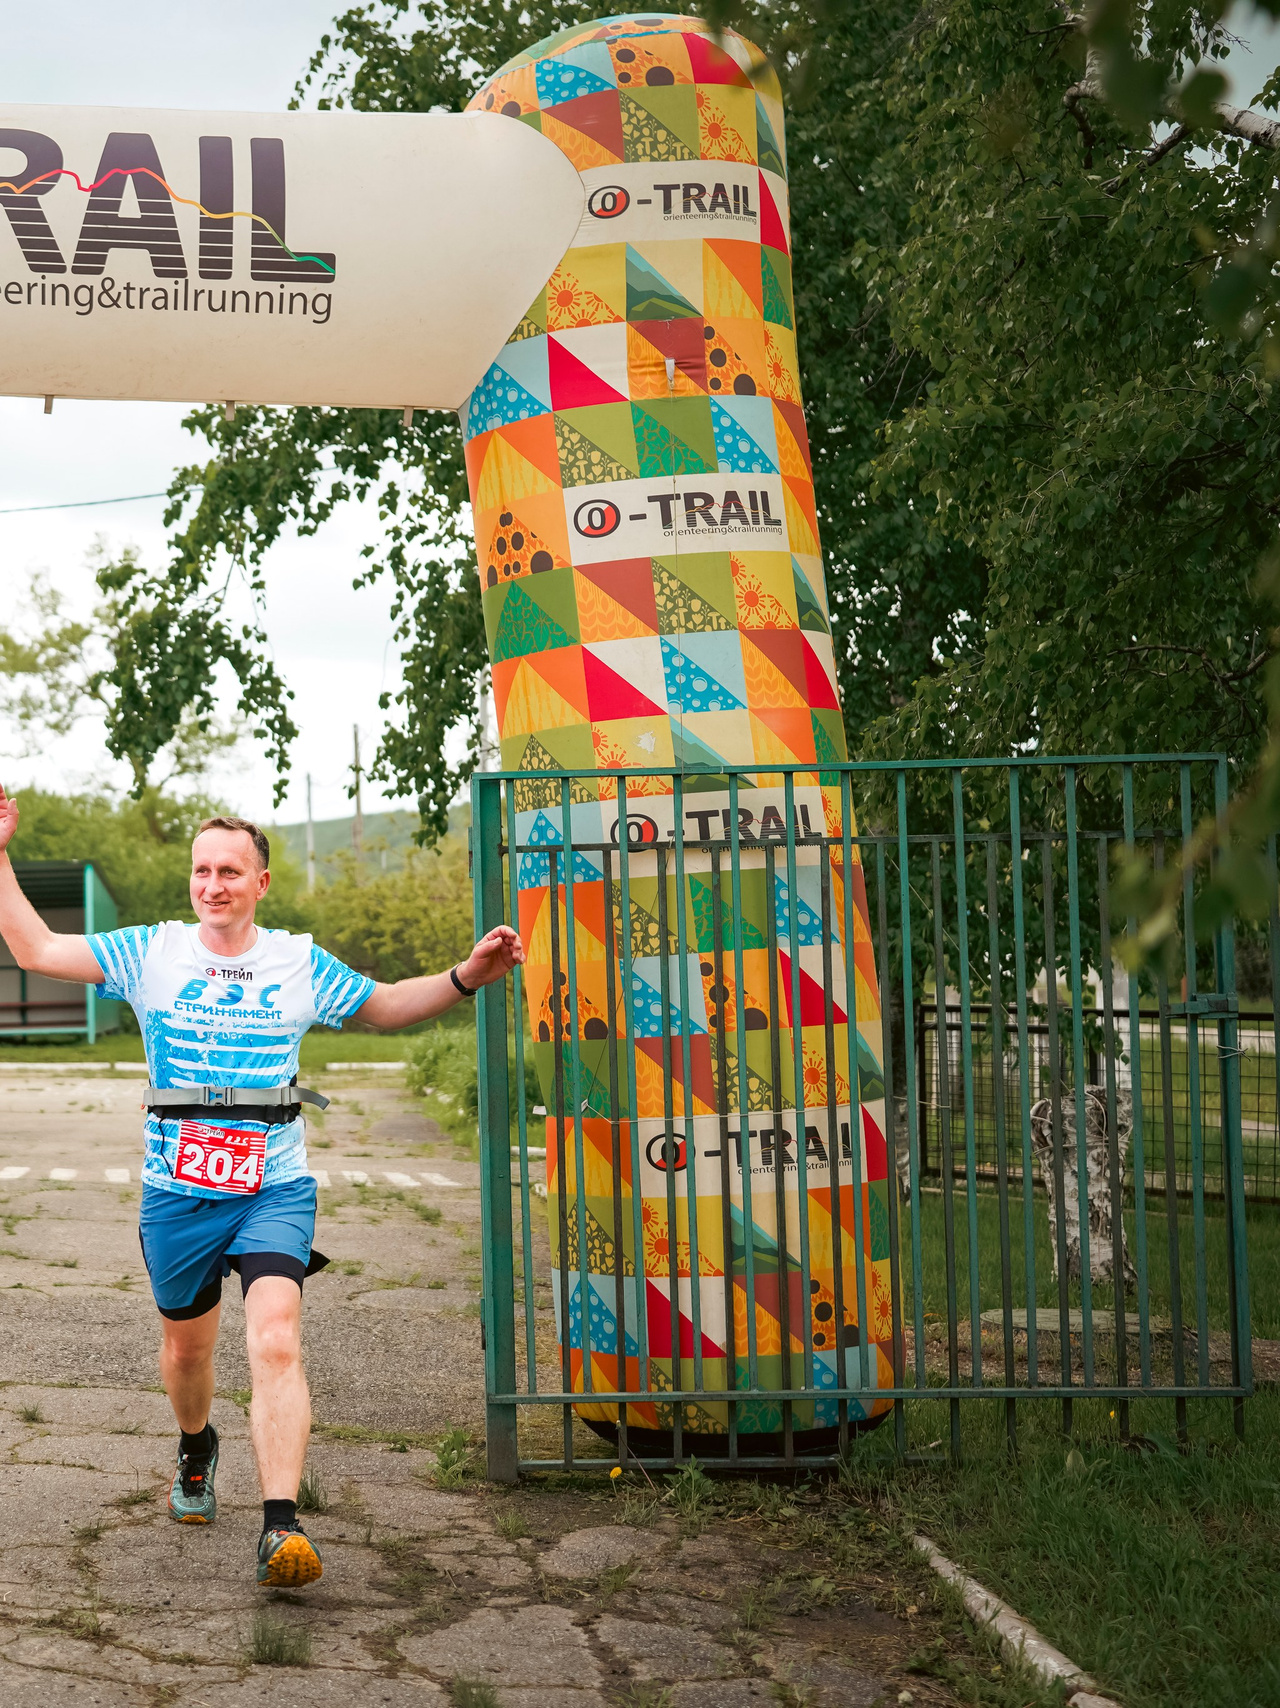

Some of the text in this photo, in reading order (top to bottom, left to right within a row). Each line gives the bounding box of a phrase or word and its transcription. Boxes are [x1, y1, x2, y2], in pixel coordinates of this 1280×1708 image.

[663, 212, 757, 225] orienteering&trailrunning
[174, 1000, 282, 1019] СТРИЖАМЕНТ
[181, 1143, 260, 1188] 204
